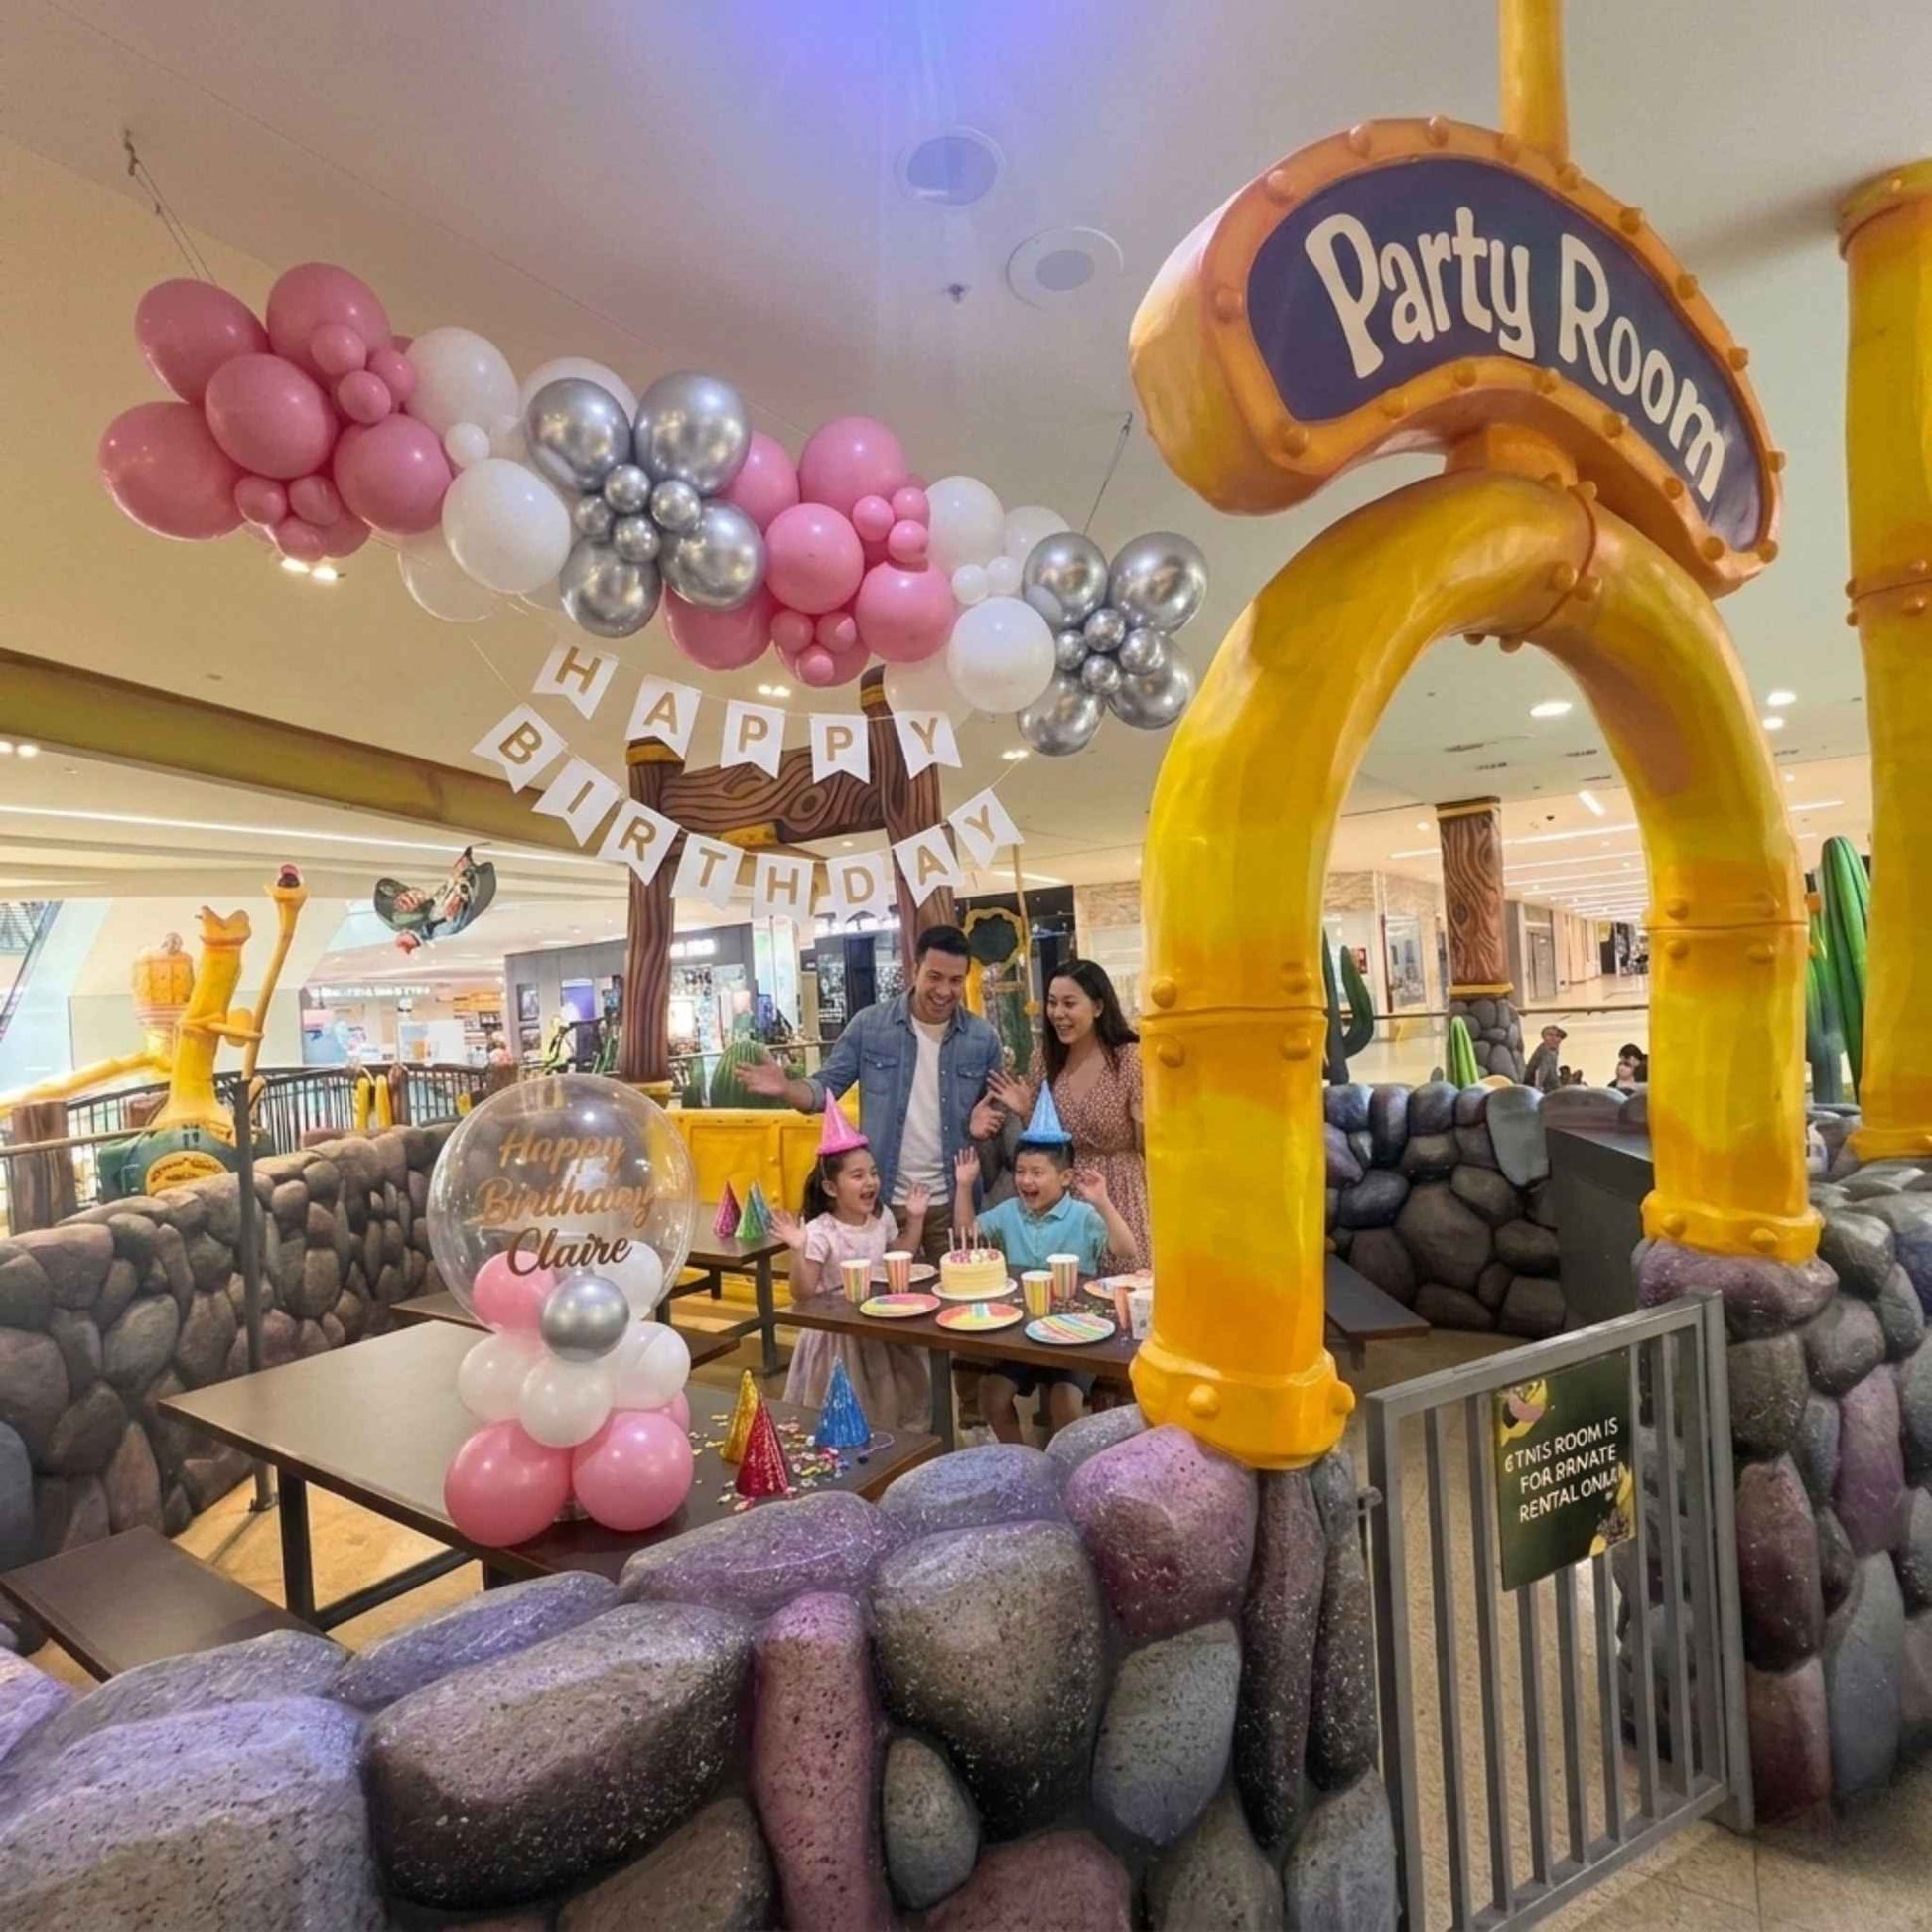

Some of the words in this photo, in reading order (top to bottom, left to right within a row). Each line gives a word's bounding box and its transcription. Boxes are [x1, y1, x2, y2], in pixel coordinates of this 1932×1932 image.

[1304, 207, 1535, 378] Party
[1559, 234, 1726, 502] Room
[554, 646, 939, 761] HAPPY
[497, 721, 996, 904] BIRTHDAY
[499, 1128, 625, 1178] Happy
[506, 1227, 632, 1276] Claire
[1554, 1423, 1602, 1455] ROOM
[1604, 1417, 1618, 1437] IS
[1519, 1484, 1580, 1523] RENTAL
